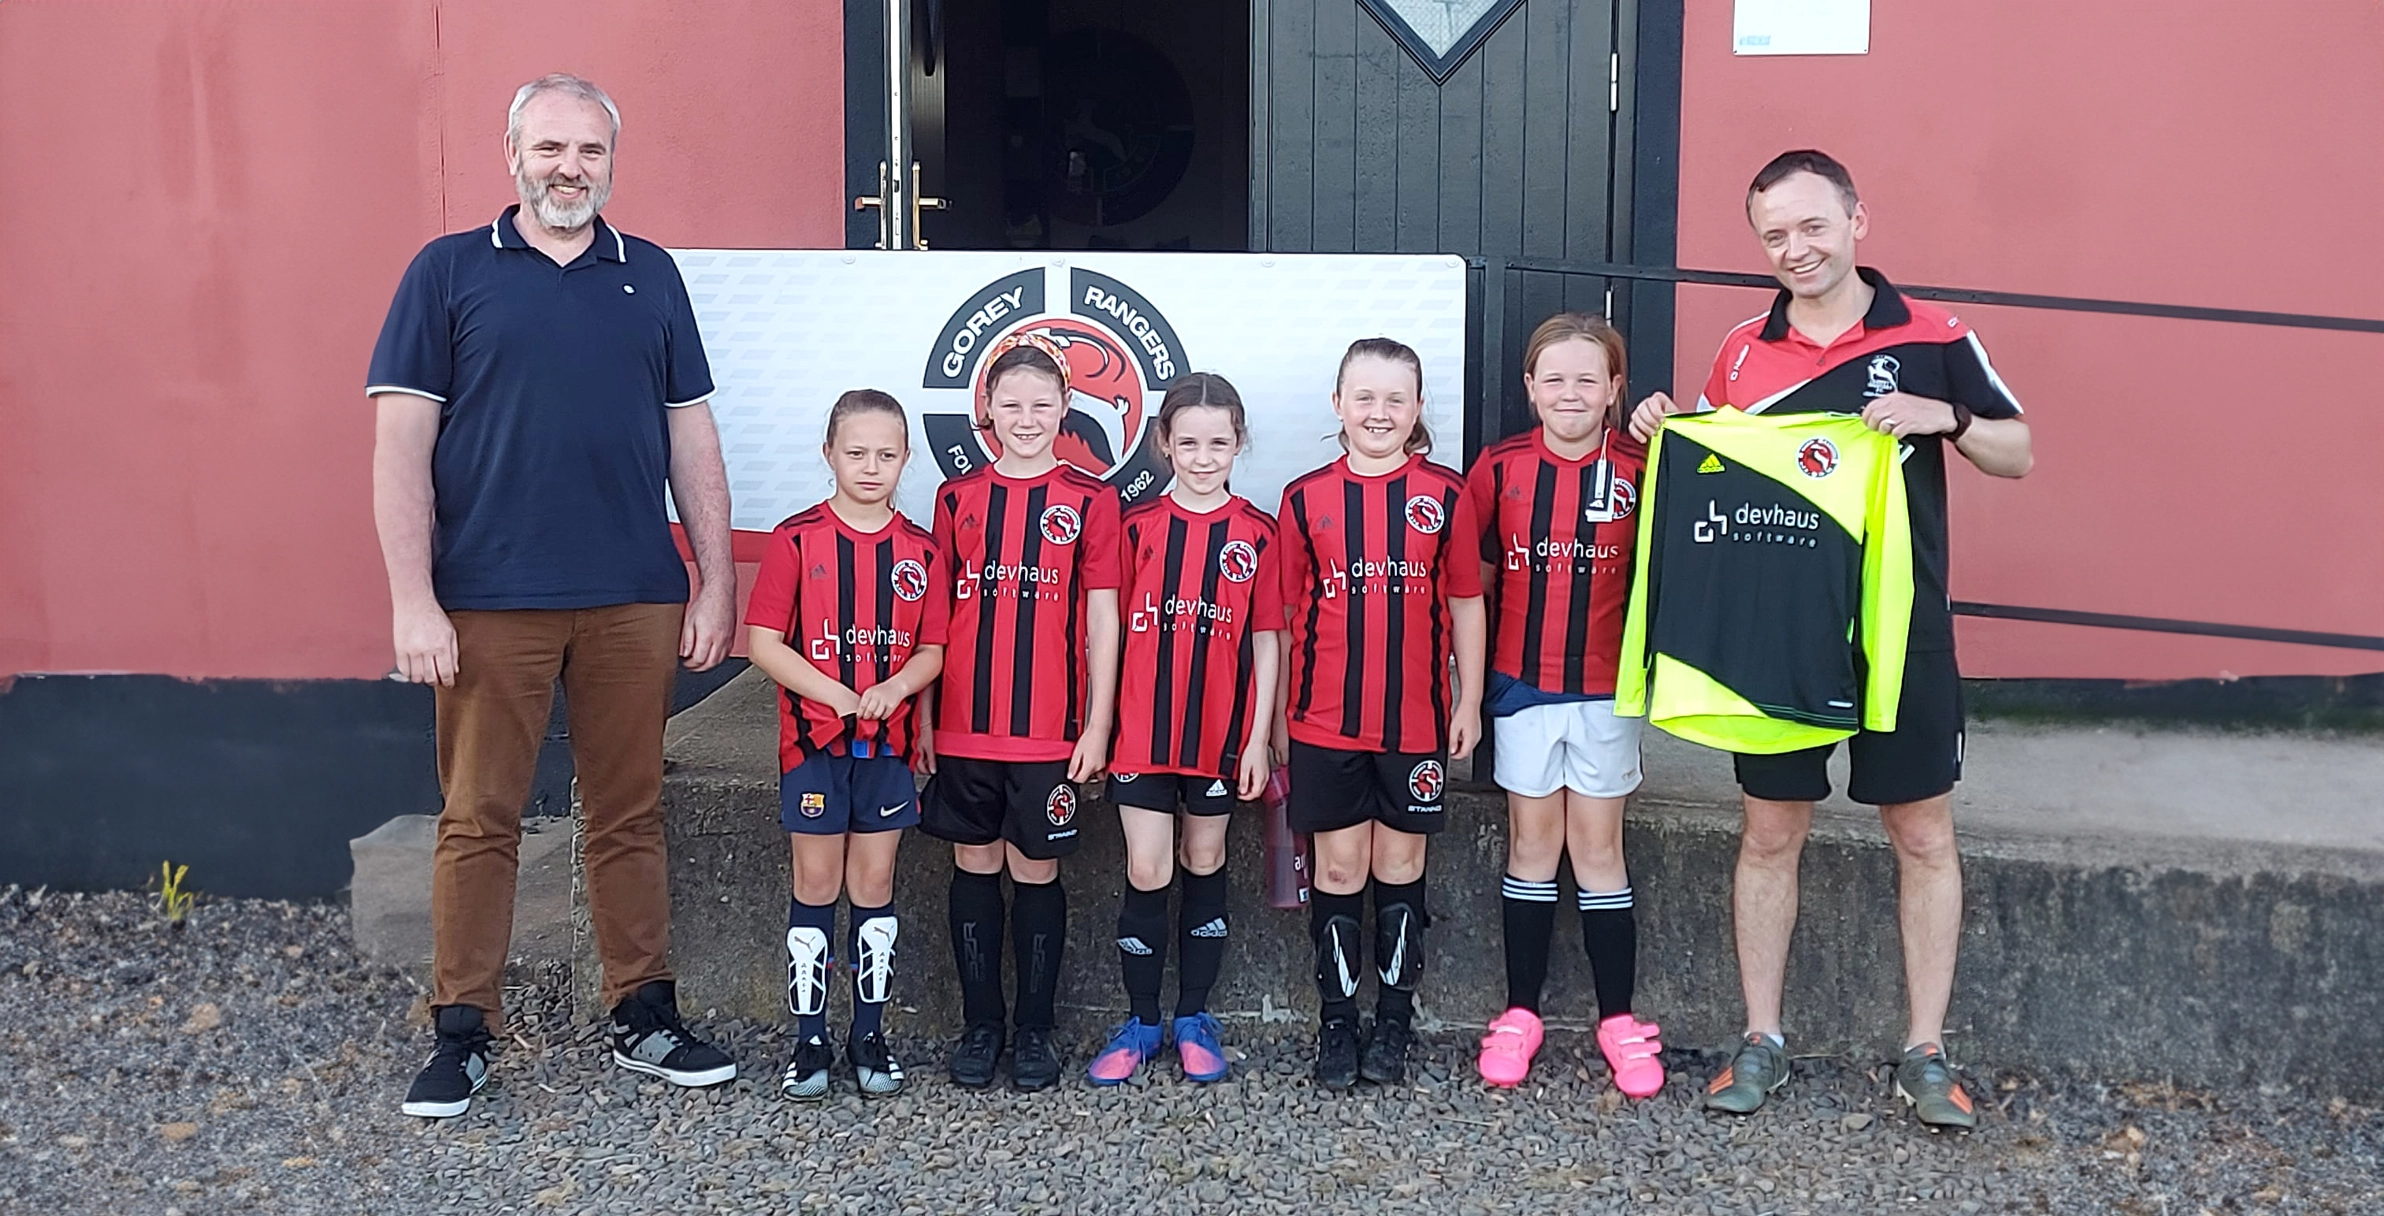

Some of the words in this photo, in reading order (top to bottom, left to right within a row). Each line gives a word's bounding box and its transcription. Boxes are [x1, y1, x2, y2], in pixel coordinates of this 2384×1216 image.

[943, 286, 1023, 378] GOREY
[1084, 285, 1176, 381] RANGERS
[1120, 470, 1155, 502] 1962
[1735, 501, 1819, 530] devhaus
[1536, 536, 1619, 558] devhaus
[1733, 531, 1817, 548] software
[984, 559, 1059, 584] devhaus
[1351, 554, 1427, 578] devhaus
[1164, 593, 1232, 623] devhaus
[845, 623, 910, 648] devhaus
